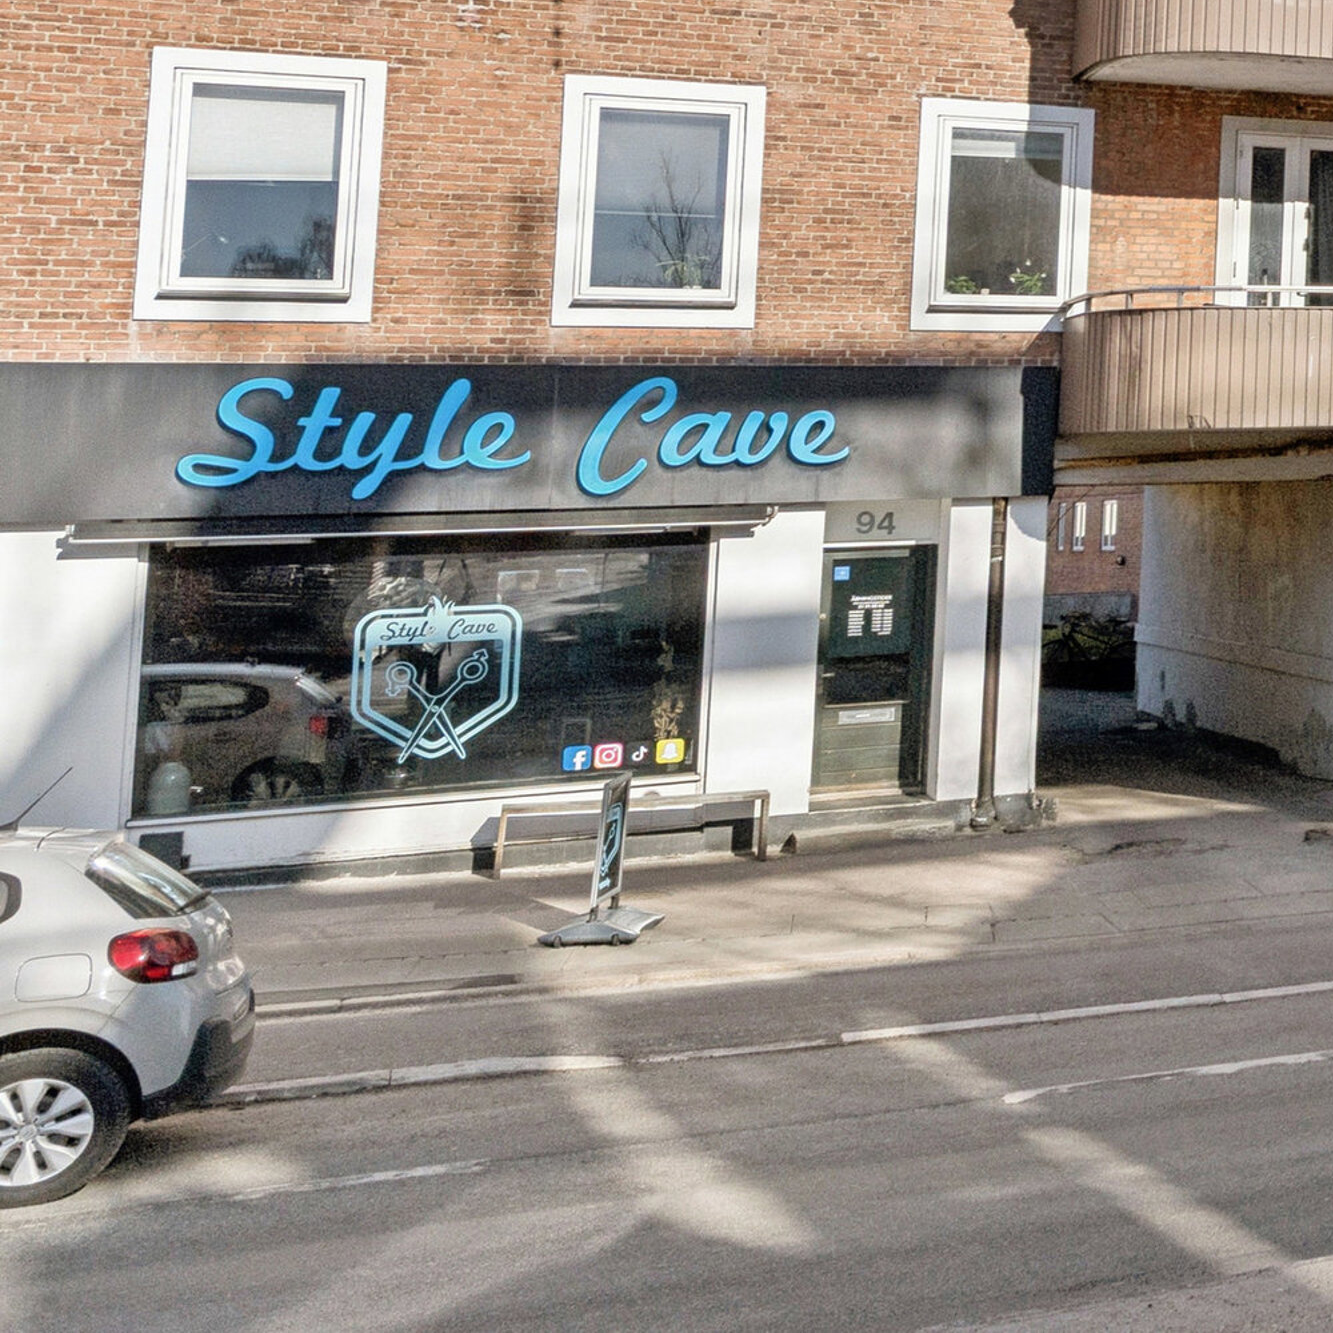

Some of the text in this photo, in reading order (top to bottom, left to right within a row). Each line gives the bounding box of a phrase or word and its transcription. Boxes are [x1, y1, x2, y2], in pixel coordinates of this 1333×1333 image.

[175, 376, 850, 501] Style Cave
[856, 511, 896, 535] 94
[380, 618, 498, 642] Styl Cave
